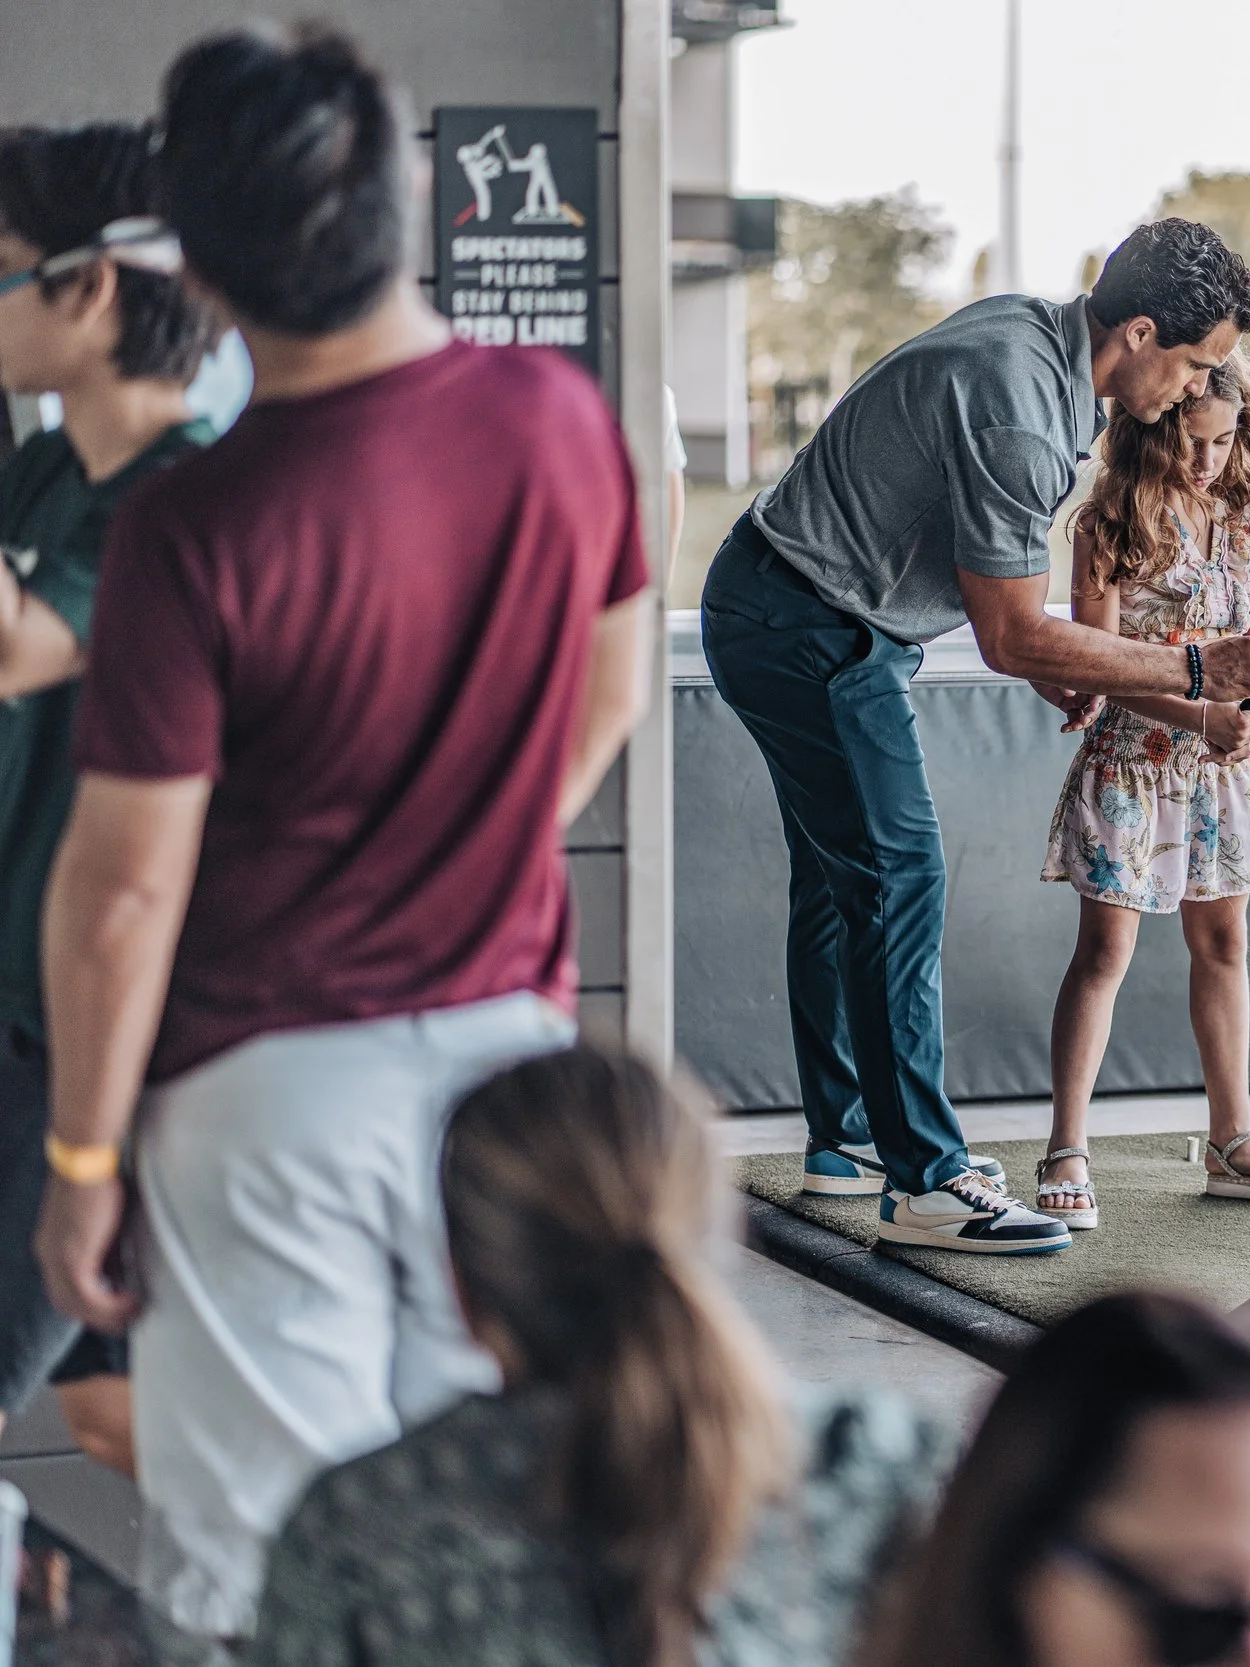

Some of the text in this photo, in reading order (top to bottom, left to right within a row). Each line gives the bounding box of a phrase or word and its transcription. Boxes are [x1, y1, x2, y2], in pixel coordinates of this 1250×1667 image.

[480, 263, 557, 288] PLEASE
[452, 289, 588, 314] STAY BEHIND
[516, 315, 588, 346] LINE
